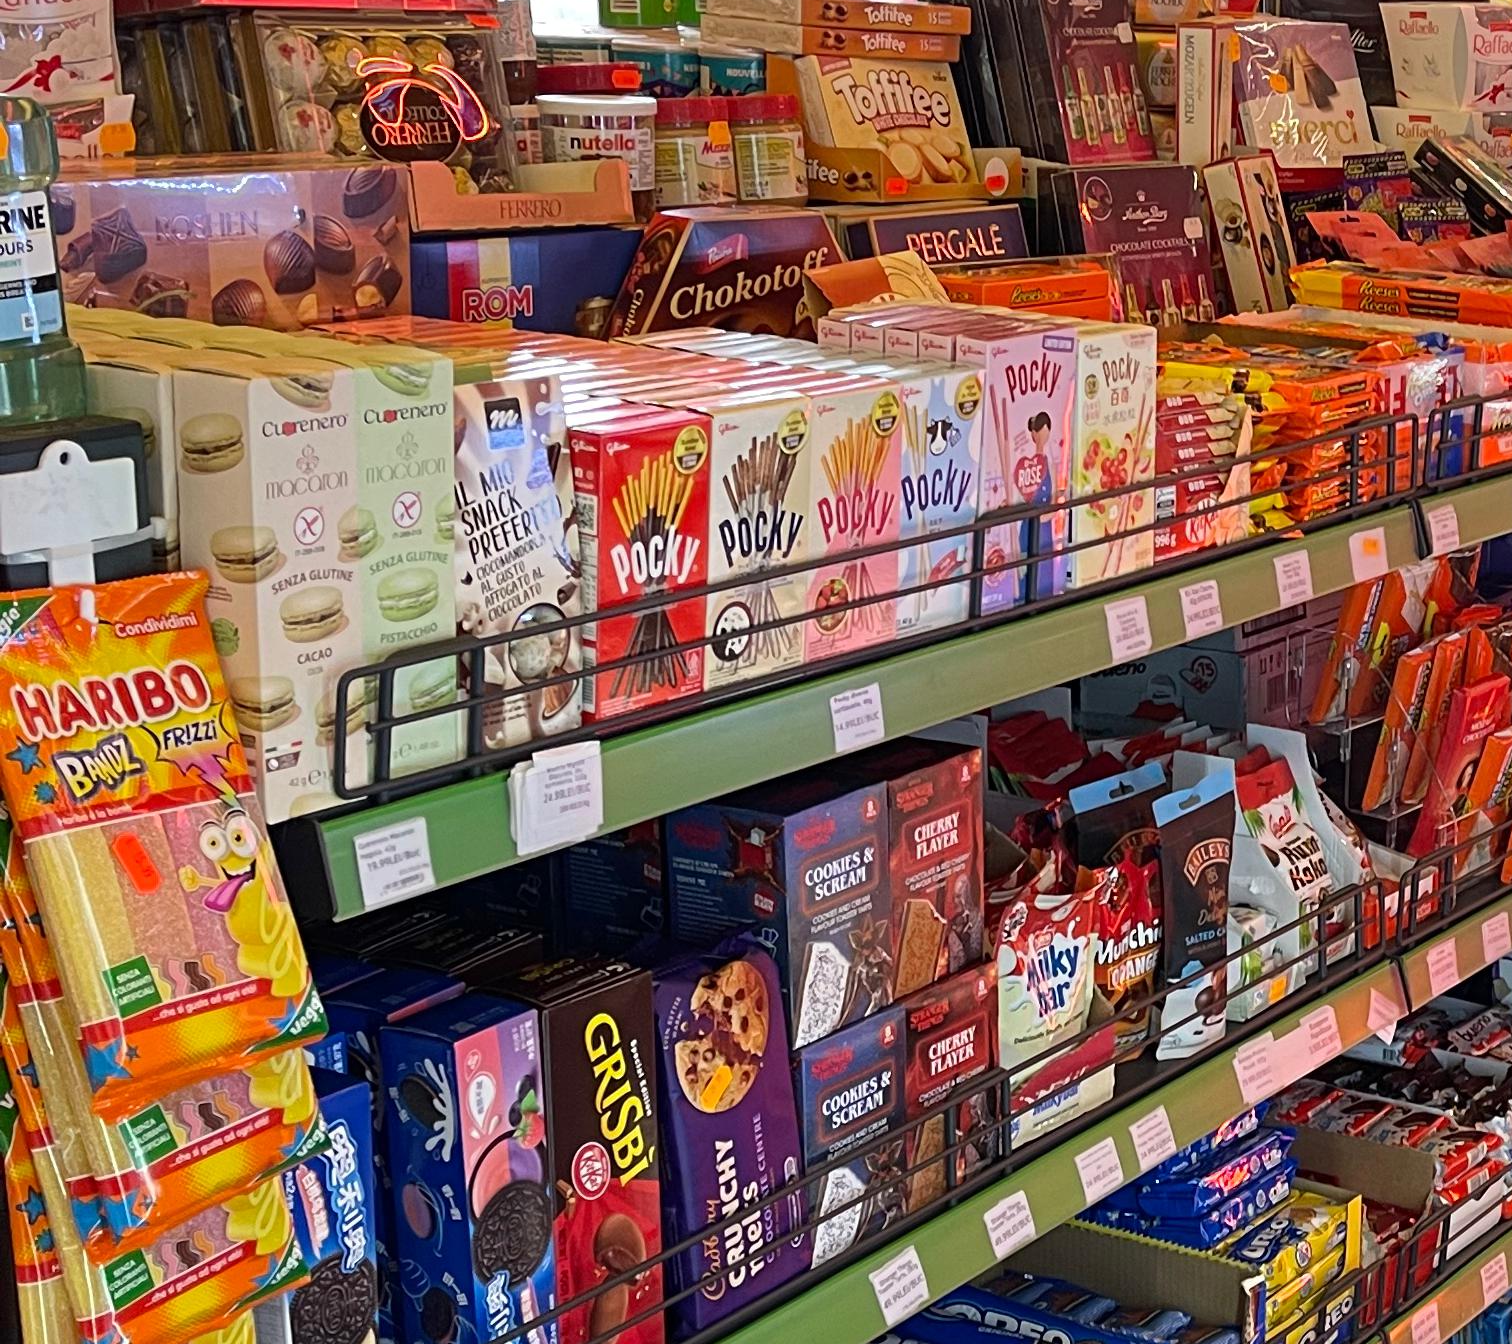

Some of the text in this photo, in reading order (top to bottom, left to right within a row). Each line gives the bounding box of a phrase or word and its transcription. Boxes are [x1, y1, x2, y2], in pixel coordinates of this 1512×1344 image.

[864, 5, 913, 27] Toffifee
[860, 33, 906, 53] Toffifee
[833, 68, 951, 127] Toffifee
[570, 132, 637, 153] nutella
[499, 198, 562, 220] FERRERO
[669, 245, 829, 321] Chokotoff
[463, 285, 533, 321] ROM
[1005, 352, 1062, 403] POCKY
[1102, 351, 1141, 388] POCKY
[265, 470, 348, 502] macaron
[365, 457, 446, 485] macaron
[901, 460, 972, 519] POCKY
[461, 490, 524, 537] SNACK
[817, 485, 895, 543] POCKY
[719, 509, 804, 567] POCKY
[368, 551, 448, 576] SENZA GLUTINE
[611, 527, 700, 593] POCKY
[271, 569, 354, 595] SENZA GLUTINE
[114, 611, 199, 640] Condividimi
[379, 622, 439, 644] PISTACCHIO
[296, 646, 333, 666] CACAO
[12, 662, 209, 740] HARIBO
[57, 737, 141, 799] BANDZ
[913, 811, 961, 845] CHERRY
[916, 830, 960, 861] FLAYER
[804, 846, 875, 888] COOKIES &
[814, 867, 867, 902] SCREAM
[1026, 945, 1080, 992] Milky
[928, 1025, 977, 1062] CHERRY
[930, 1044, 976, 1077] FLAYER
[821, 1070, 893, 1118] COOKIES &
[831, 1090, 884, 1130] SCREAM
